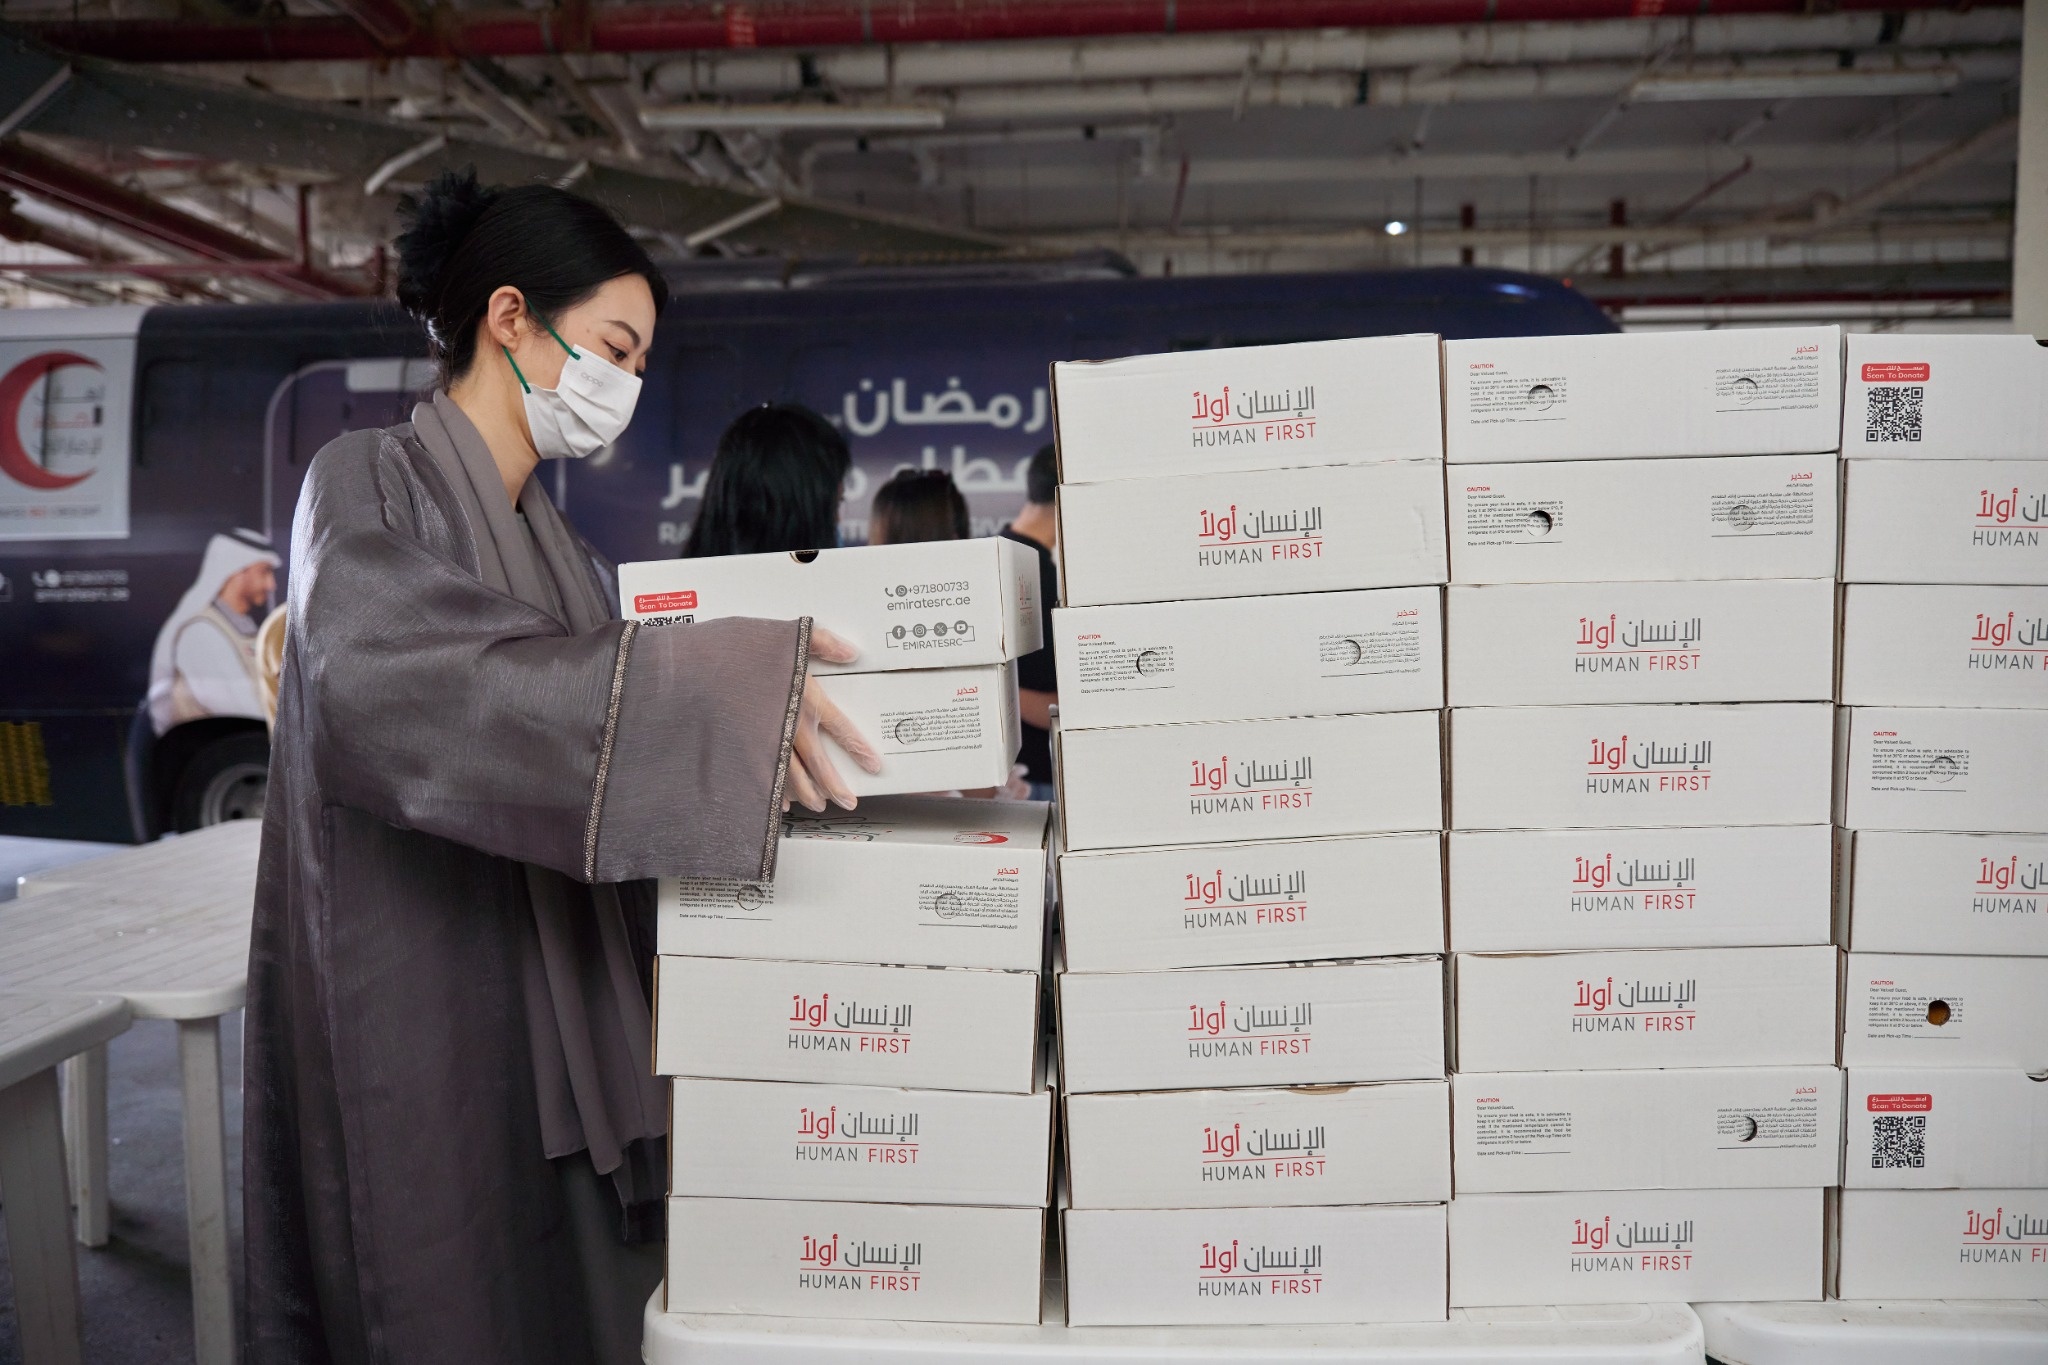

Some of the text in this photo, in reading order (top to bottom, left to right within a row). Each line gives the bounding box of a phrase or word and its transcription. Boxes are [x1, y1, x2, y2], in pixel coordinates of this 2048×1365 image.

[1796, 344, 1819, 354] تحذير
[1237, 386, 1314, 419] الإنسان
[1193, 421, 1316, 447] HUMAN FIRST
[1790, 472, 1813, 481] تحذير
[1243, 507, 1321, 538] الإنسان
[1973, 531, 2038, 546] HUMAN
[1199, 541, 1322, 566] HUMAN FIRST
[908, 581, 969, 594] +971800733
[668, 600, 693, 608] Donate
[887, 596, 971, 611] emiratesrc.ae
[1396, 608, 1419, 618] تحذير
[1622, 618, 1700, 648] الإنسان
[902, 638, 963, 650] EMIRATESRC
[1576, 654, 1700, 672] HUMAN FIRST
[1969, 654, 2033, 669] HUMAN
[956, 687, 979, 697] تحذير
[1633, 741, 1711, 769] الإنسان
[1235, 757, 1311, 787] الإنسان
[1587, 775, 1710, 793] HUMAN FIRST
[1191, 792, 1312, 814] HUMAN FIRST
[996, 867, 1020, 877] تحذير
[1617, 858, 1694, 887] الإنسان
[1228, 870, 1305, 902] الإنسان
[1572, 893, 1695, 911] HUMAN FIRST
[1973, 899, 2036, 913] HUMAN
[1185, 905, 1306, 929] HUMAN FIRST
[1618, 980, 1695, 1008] الإنسان
[834, 1002, 911, 1032] الإنسان
[1234, 1003, 1311, 1032] الإنسان
[1573, 1015, 1696, 1032] HUMAN FIRST
[789, 1034, 910, 1054] HUMAN FIRST
[1190, 1038, 1310, 1057] HUMAN FIRST
[1795, 1087, 1818, 1096] تحذير
[841, 1112, 918, 1142] الإنسان
[1247, 1126, 1325, 1156] الإنسان
[796, 1146, 918, 1164] HUMAN FIRST
[1203, 1160, 1325, 1181] HUMAN FIRST
[1617, 1221, 1693, 1249] الإنسان
[845, 1241, 921, 1270] الإنسان
[1244, 1245, 1321, 1273] الإنسان
[1572, 1255, 1692, 1271] HUMAN FIRST
[1961, 1249, 2021, 1262] HUMAN
[800, 1274, 920, 1291] HUMAN FIRST
[1199, 1278, 1321, 1296] HUMAN FIRST
